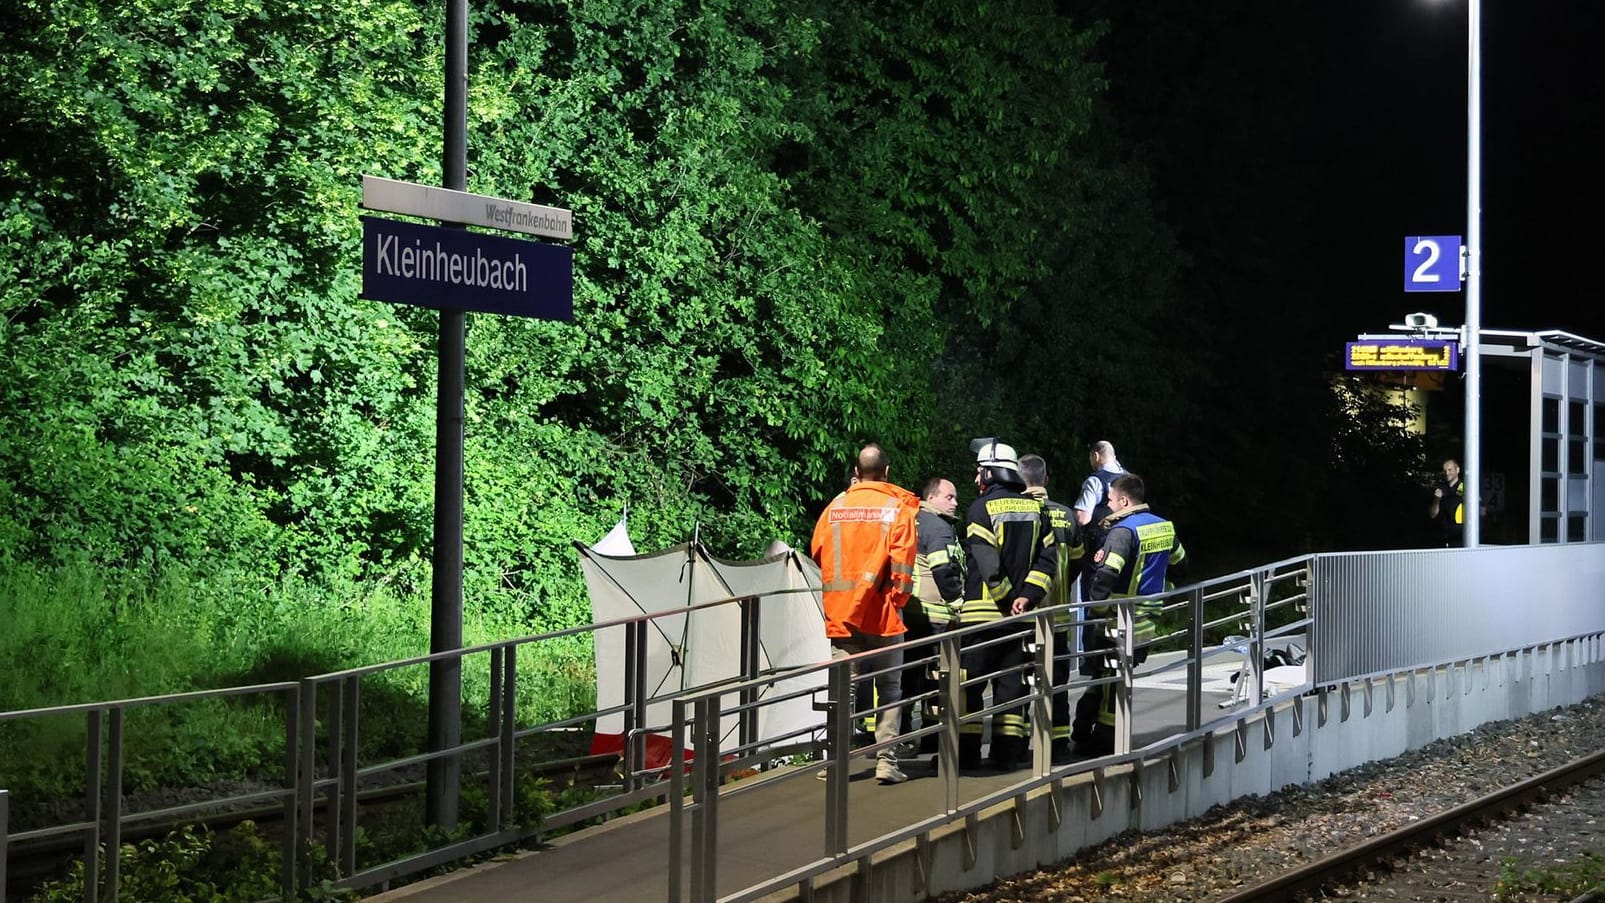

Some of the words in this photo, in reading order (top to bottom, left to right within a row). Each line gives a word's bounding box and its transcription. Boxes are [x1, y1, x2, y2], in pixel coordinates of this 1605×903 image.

[485, 203, 568, 233] Westfrankenbahn
[376, 233, 528, 293] Kleinheubach
[1411, 239, 1440, 283] 2
